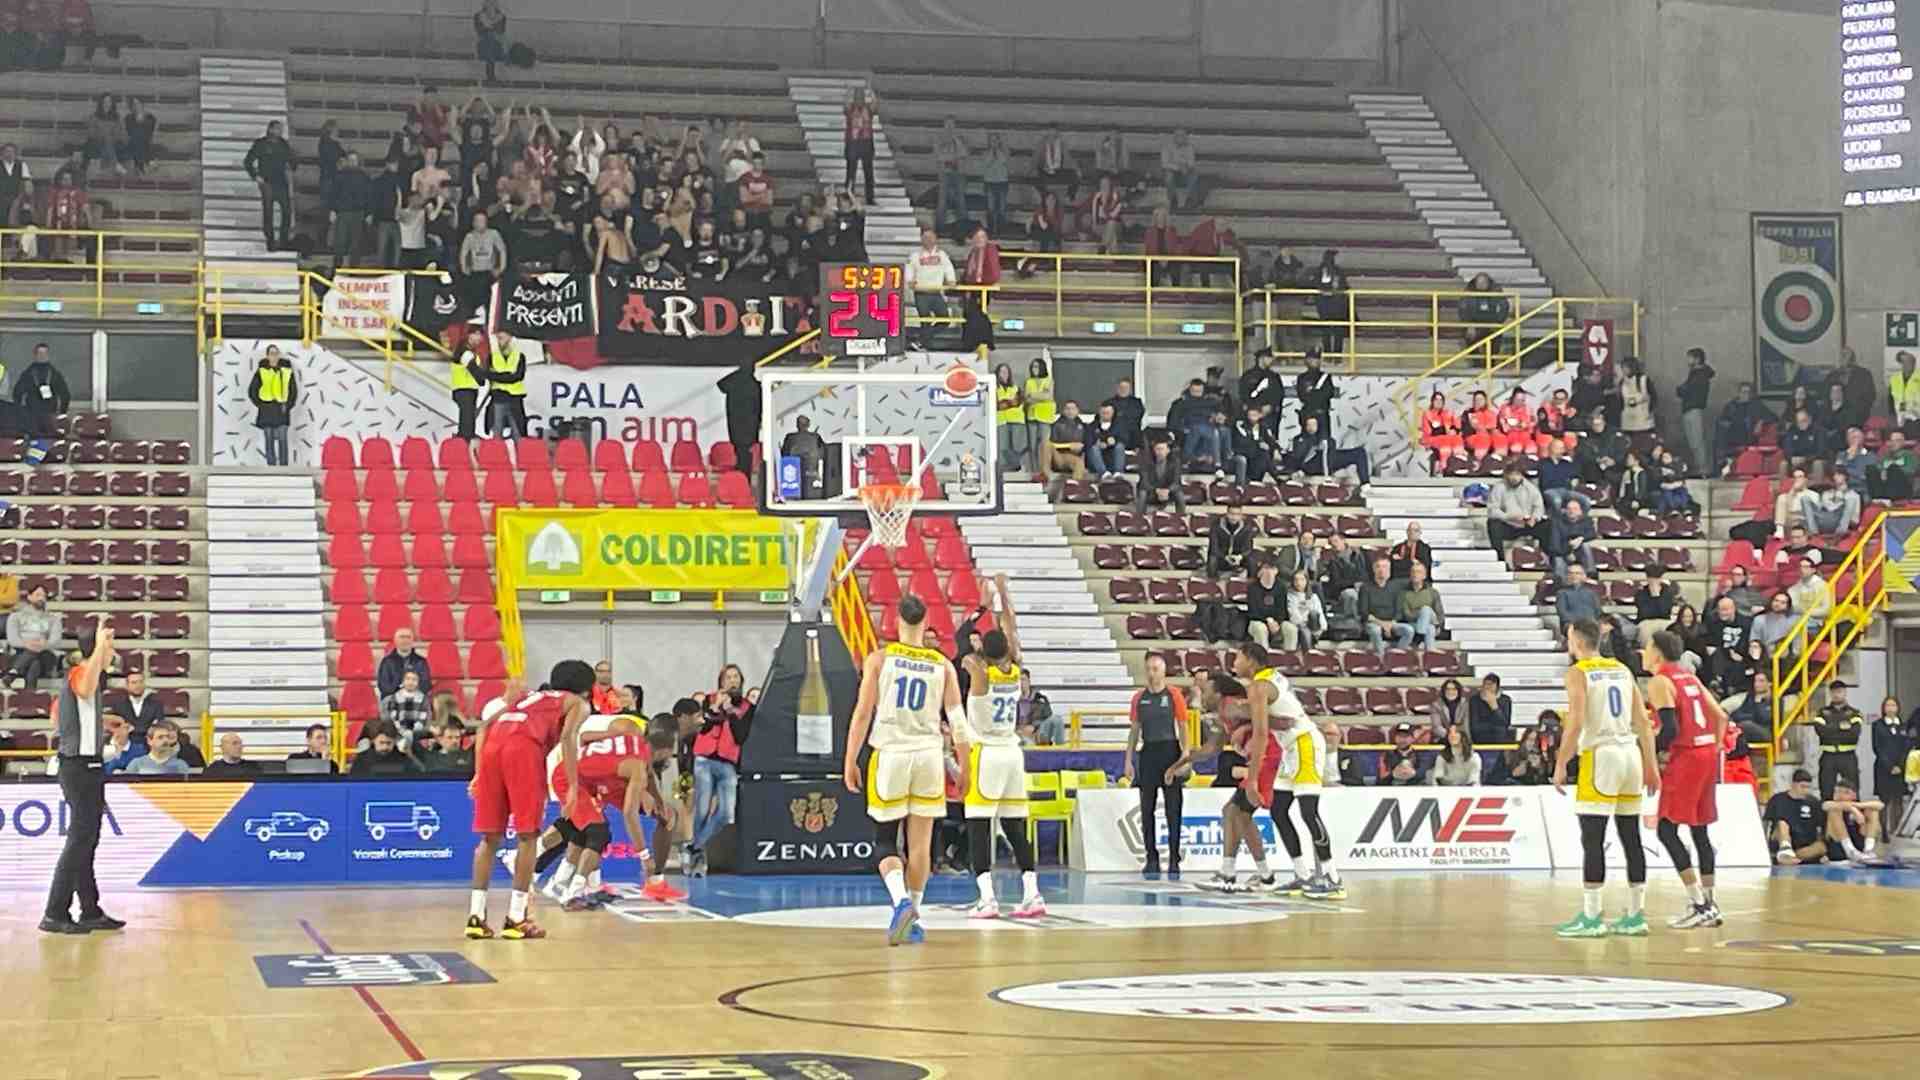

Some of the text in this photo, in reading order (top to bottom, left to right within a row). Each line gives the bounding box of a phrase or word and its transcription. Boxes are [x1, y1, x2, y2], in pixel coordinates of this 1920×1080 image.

[1843, 18, 1896, 35] FERRARI
[1842, 51, 1902, 69] JOHNSON
[1843, 103, 1903, 120] ROSSELLI
[1843, 119, 1911, 137] ANDERSON
[1843, 154, 1902, 172] SANDERS
[608, 275, 686, 291] VRESE
[843, 266, 901, 290] 5:37
[506, 301, 584, 327] PRESENTI
[829, 292, 900, 337] 24
[551, 382, 644, 409] PALA
[620, 416, 698, 443] aim
[895, 676, 928, 711] 10
[1608, 685, 1622, 718] 0
[757, 840, 873, 861] ZENATO
[1348, 846, 1429, 859] MAGRINI
